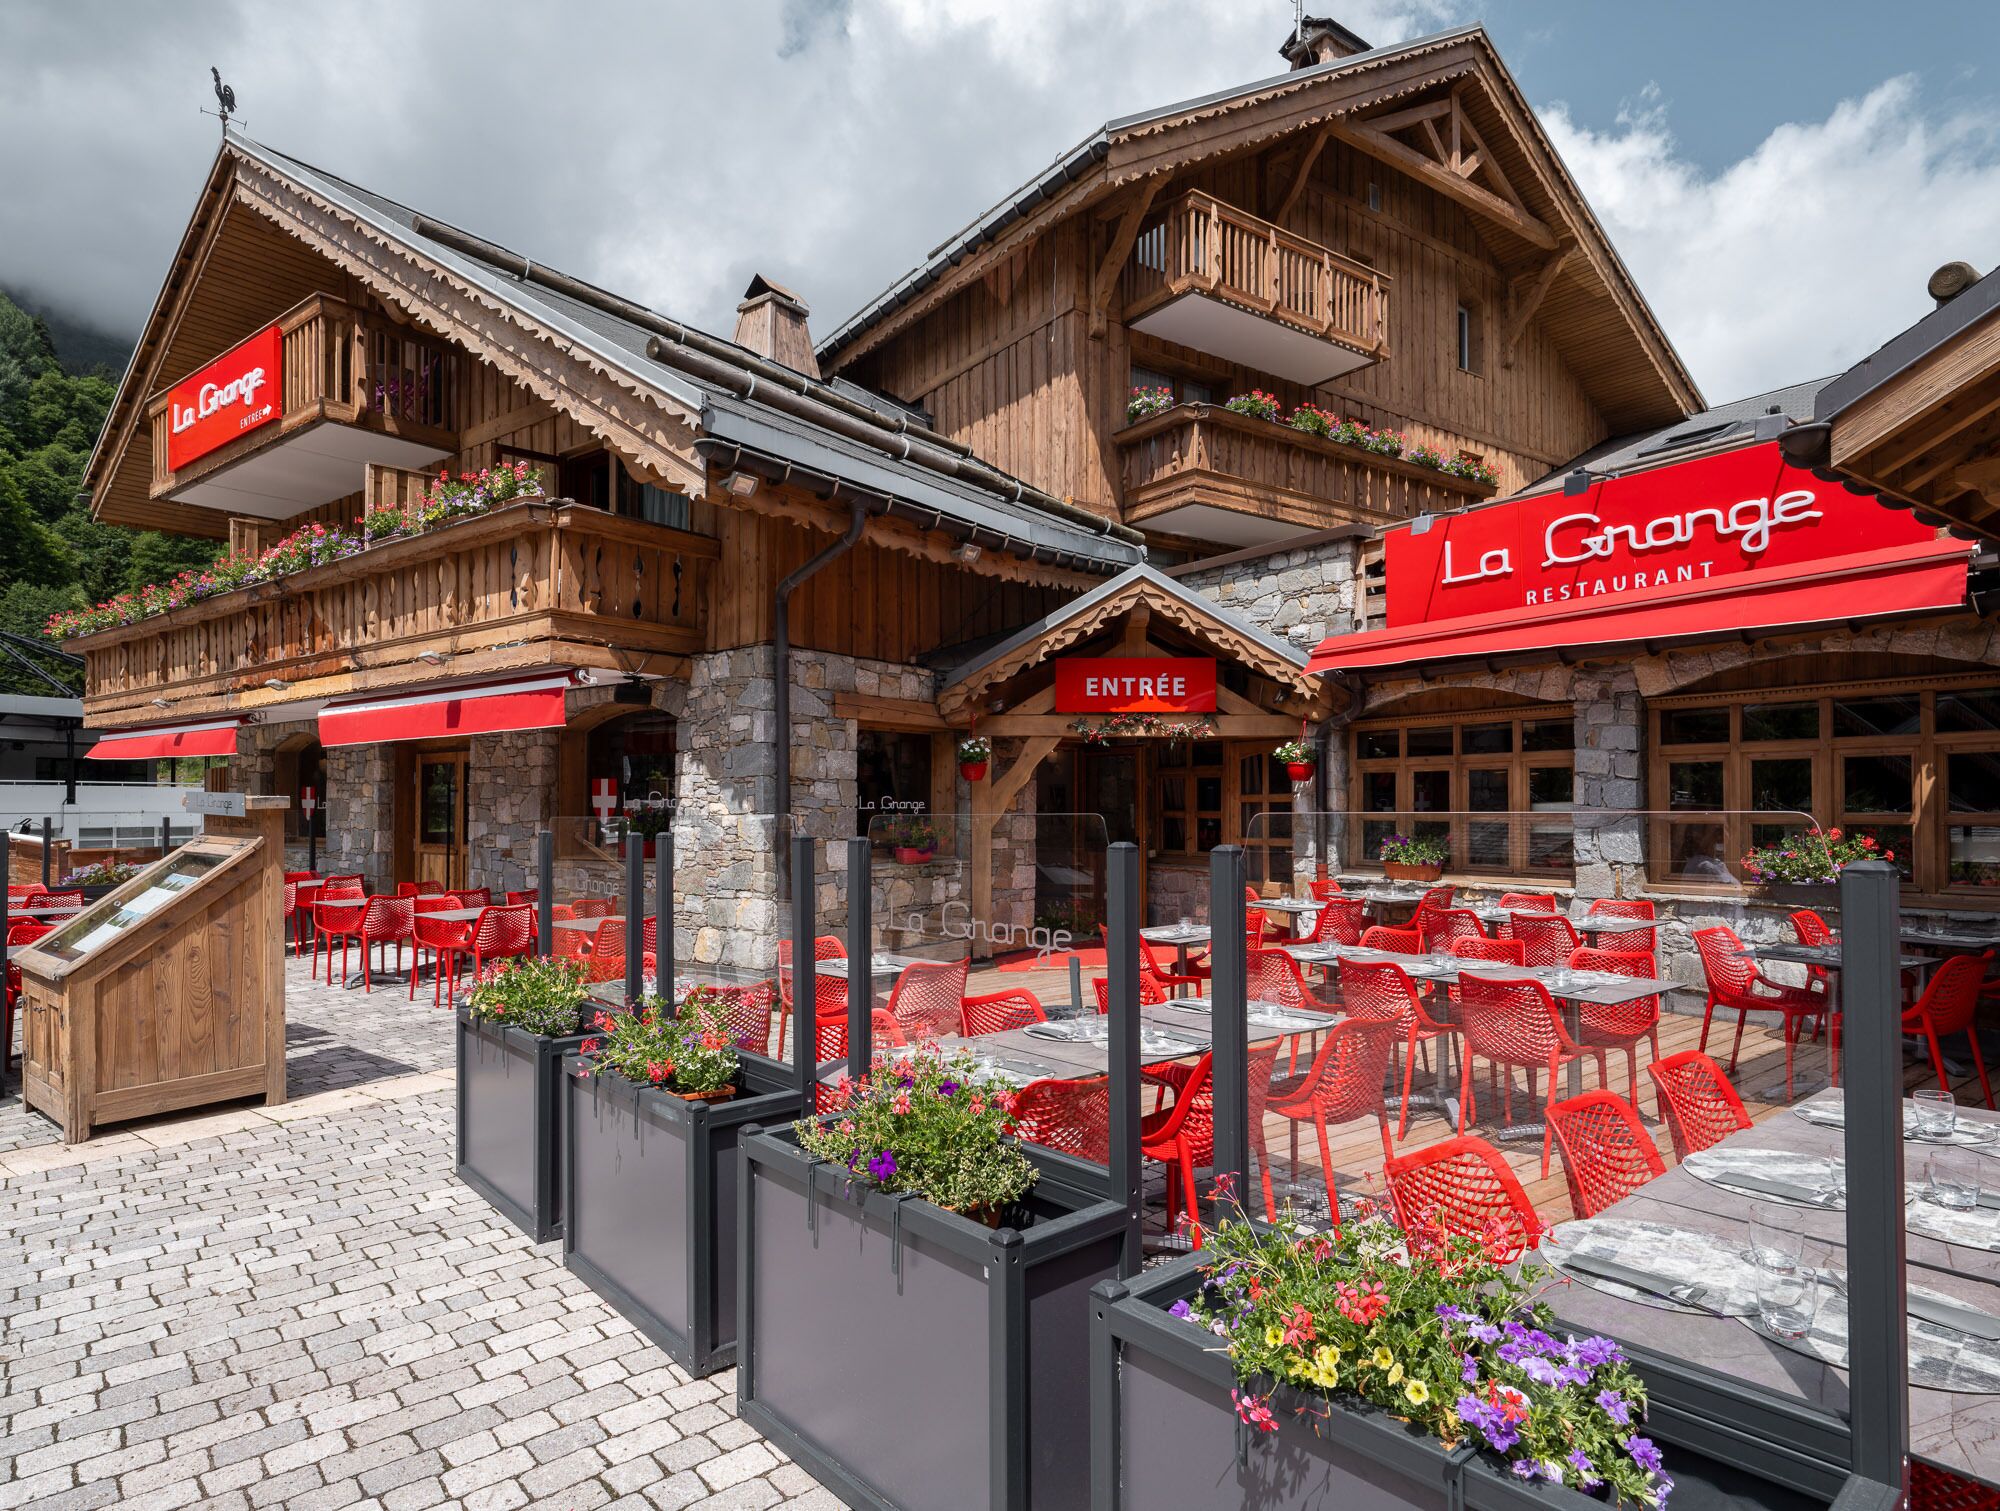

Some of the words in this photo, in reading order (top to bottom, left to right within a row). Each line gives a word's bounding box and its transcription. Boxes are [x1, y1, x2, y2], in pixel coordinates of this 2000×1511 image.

[173, 403, 196, 433] La
[198, 367, 266, 419] Grange
[240, 409, 263, 429] ENTRÉE
[1441, 540, 1514, 584] La
[1541, 490, 1824, 567] Grange
[1526, 561, 1714, 605] RESTAURANT
[1086, 673, 1186, 697] ENTRÉE
[622, 791, 641, 809] La
[859, 795, 875, 810] La
[881, 795, 926, 815] Grange
[575, 868, 620, 905] Grange
[888, 895, 925, 933] La
[940, 901, 1075, 967] Grange
